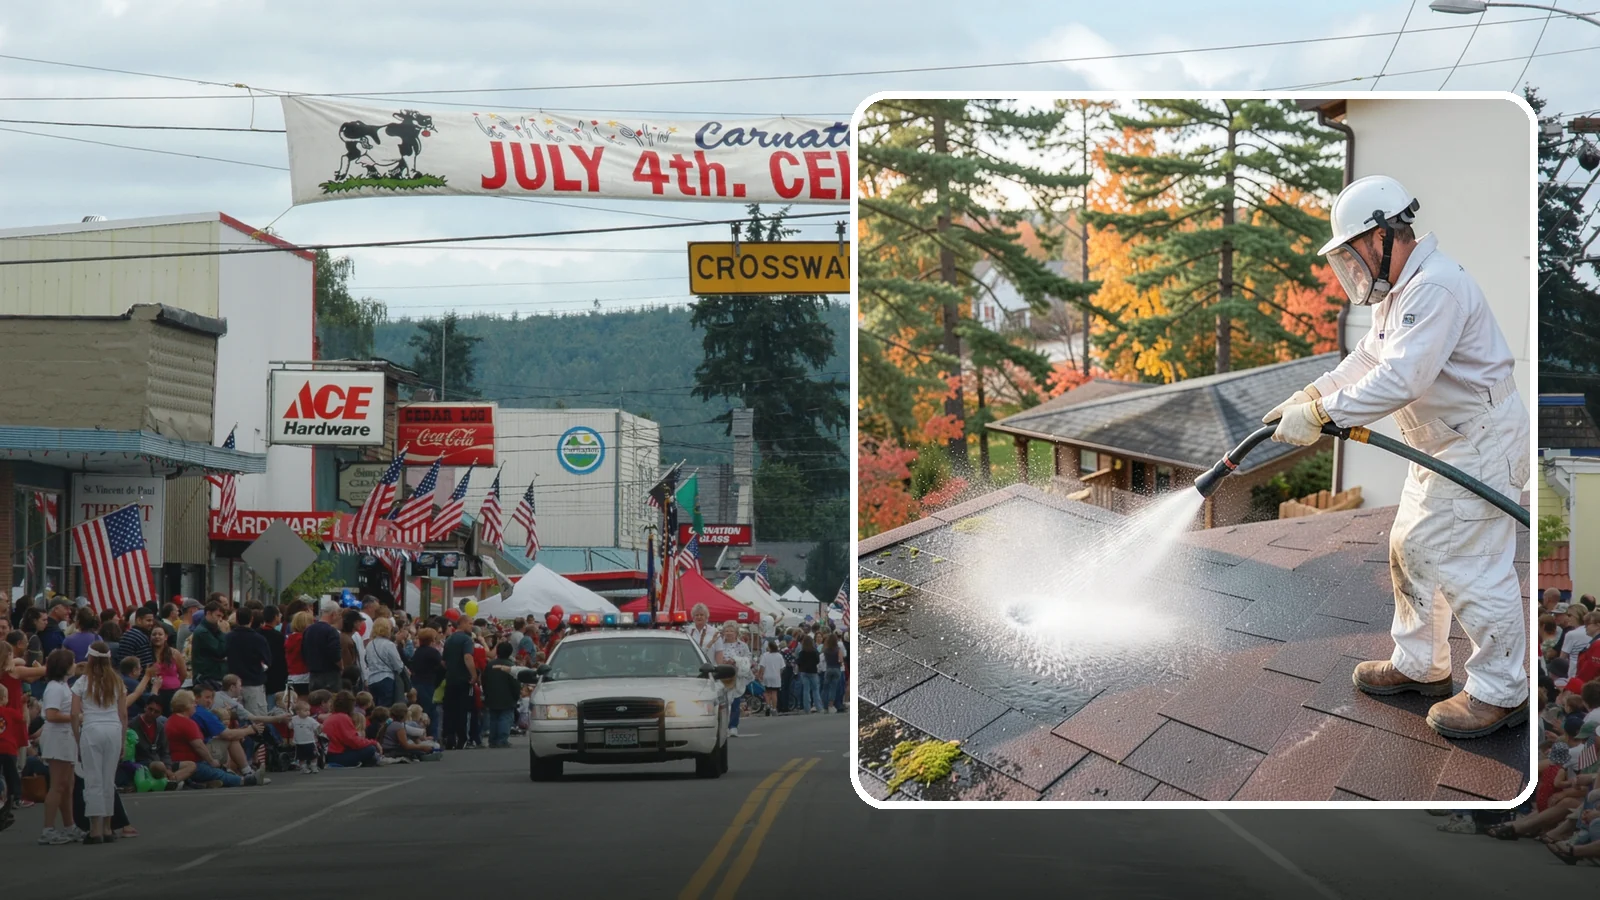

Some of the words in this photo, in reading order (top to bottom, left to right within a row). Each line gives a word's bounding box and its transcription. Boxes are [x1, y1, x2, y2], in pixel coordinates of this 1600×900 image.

[694, 121, 850, 150] Carnat
[480, 141, 605, 192] JULY
[632, 150, 747, 198] 4th.
[697, 254, 850, 280] CROSSWA
[282, 380, 373, 420] ACE
[405, 409, 452, 421] CEDAR
[460, 409, 485, 421] LOG
[283, 420, 371, 436] Hardware
[416, 428, 477, 447] Coca-Cola
[83, 485, 93, 494] St.
[95, 485, 124, 495] Vincent
[126, 485, 136, 495] de
[137, 486, 155, 496] Paul
[699, 535, 730, 543] GLASS
